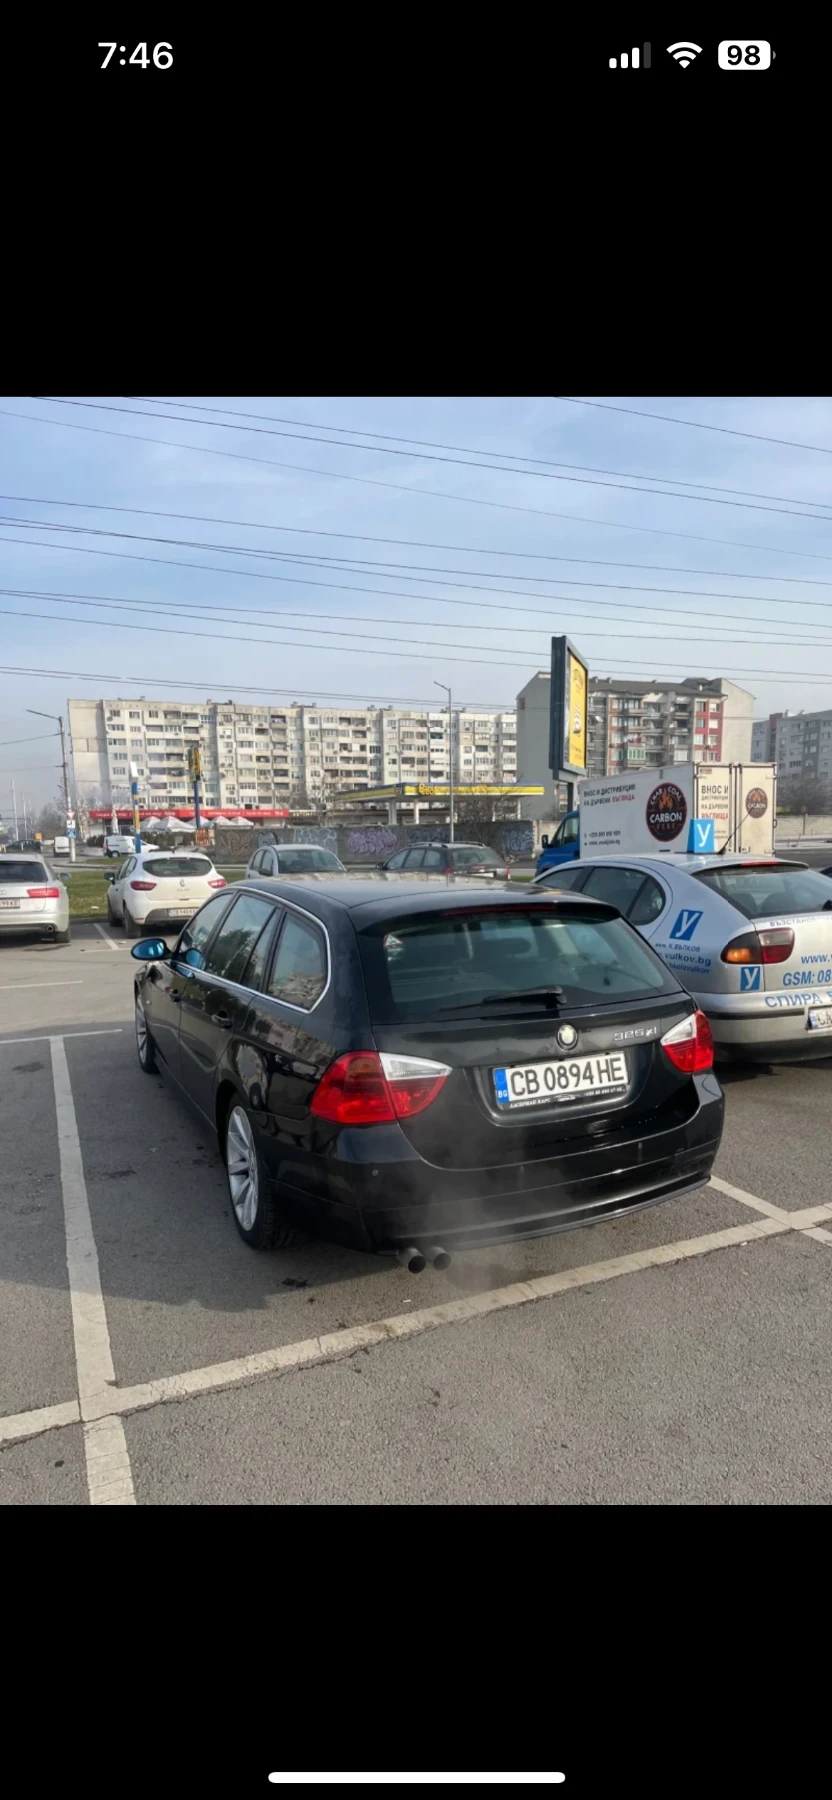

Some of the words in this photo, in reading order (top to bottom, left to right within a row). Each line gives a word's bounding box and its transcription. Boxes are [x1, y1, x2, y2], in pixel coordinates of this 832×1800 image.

[701, 785, 722, 794] ВНОС
[724, 785, 728, 794] И
[650, 812, 682, 823] CARBON
[783, 971, 815, 986] GSM:
[765, 992, 823, 1008] СПИРА
[543, 1061, 594, 1091] 0894
[498, 1090, 508, 1098] BG
